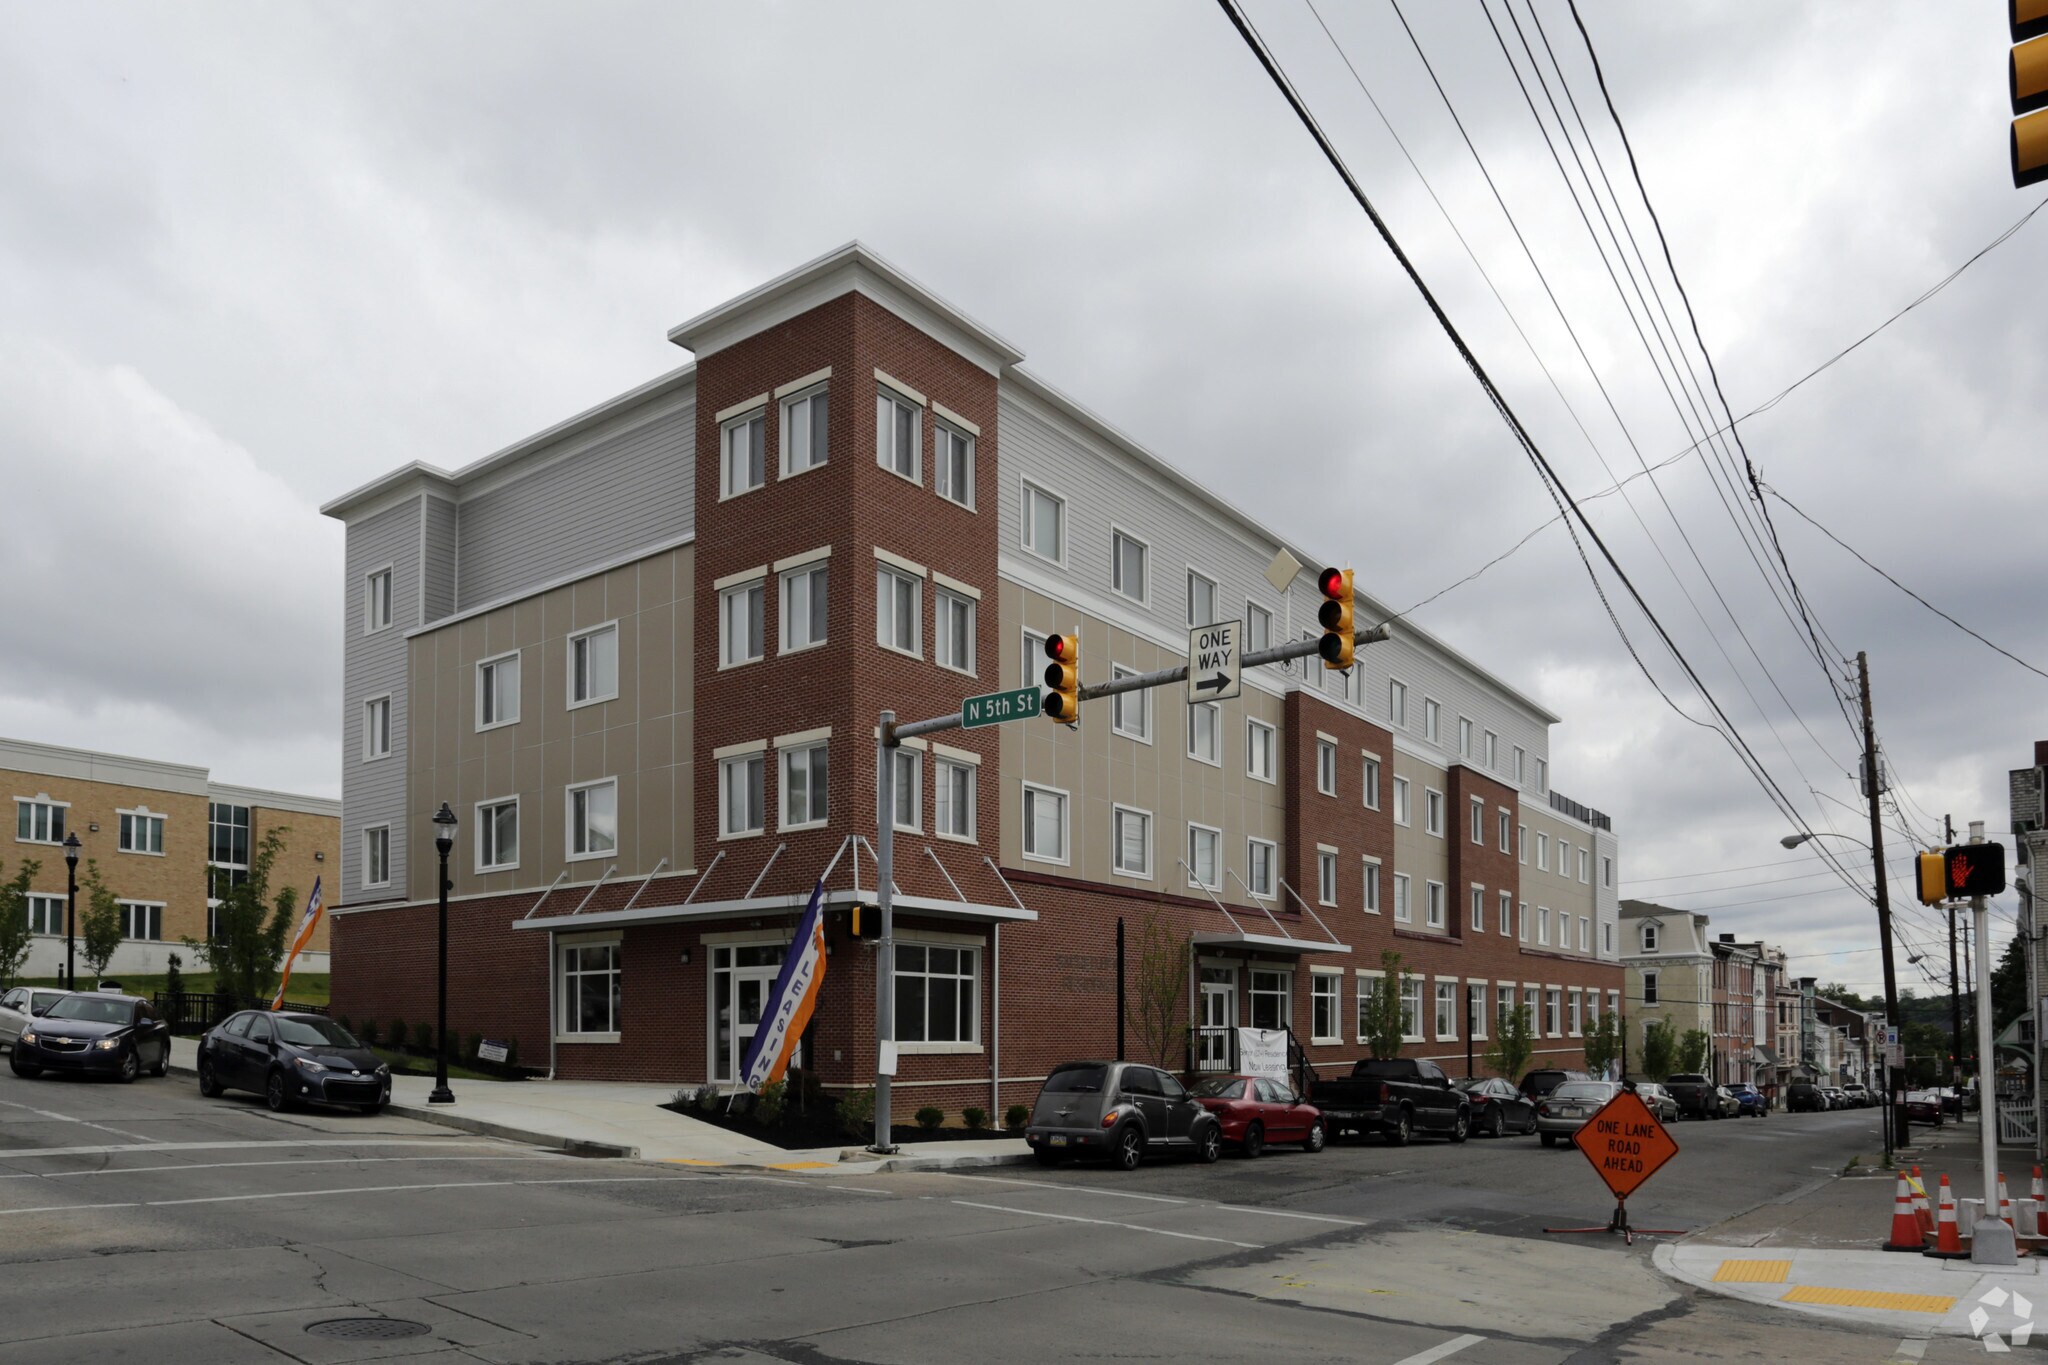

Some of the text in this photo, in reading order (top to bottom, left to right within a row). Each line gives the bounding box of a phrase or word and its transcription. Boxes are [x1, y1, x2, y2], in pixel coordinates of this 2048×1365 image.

[1199, 629, 1232, 650] ONE
[1198, 649, 1232, 670] WAY
[970, 693, 1033, 720] N 5th St
[749, 961, 809, 1089] LEASING
[1597, 1120, 1655, 1138] ONE LANE
[1608, 1140, 1640, 1155] ROAD
[1604, 1156, 1643, 1173] AHEAD
